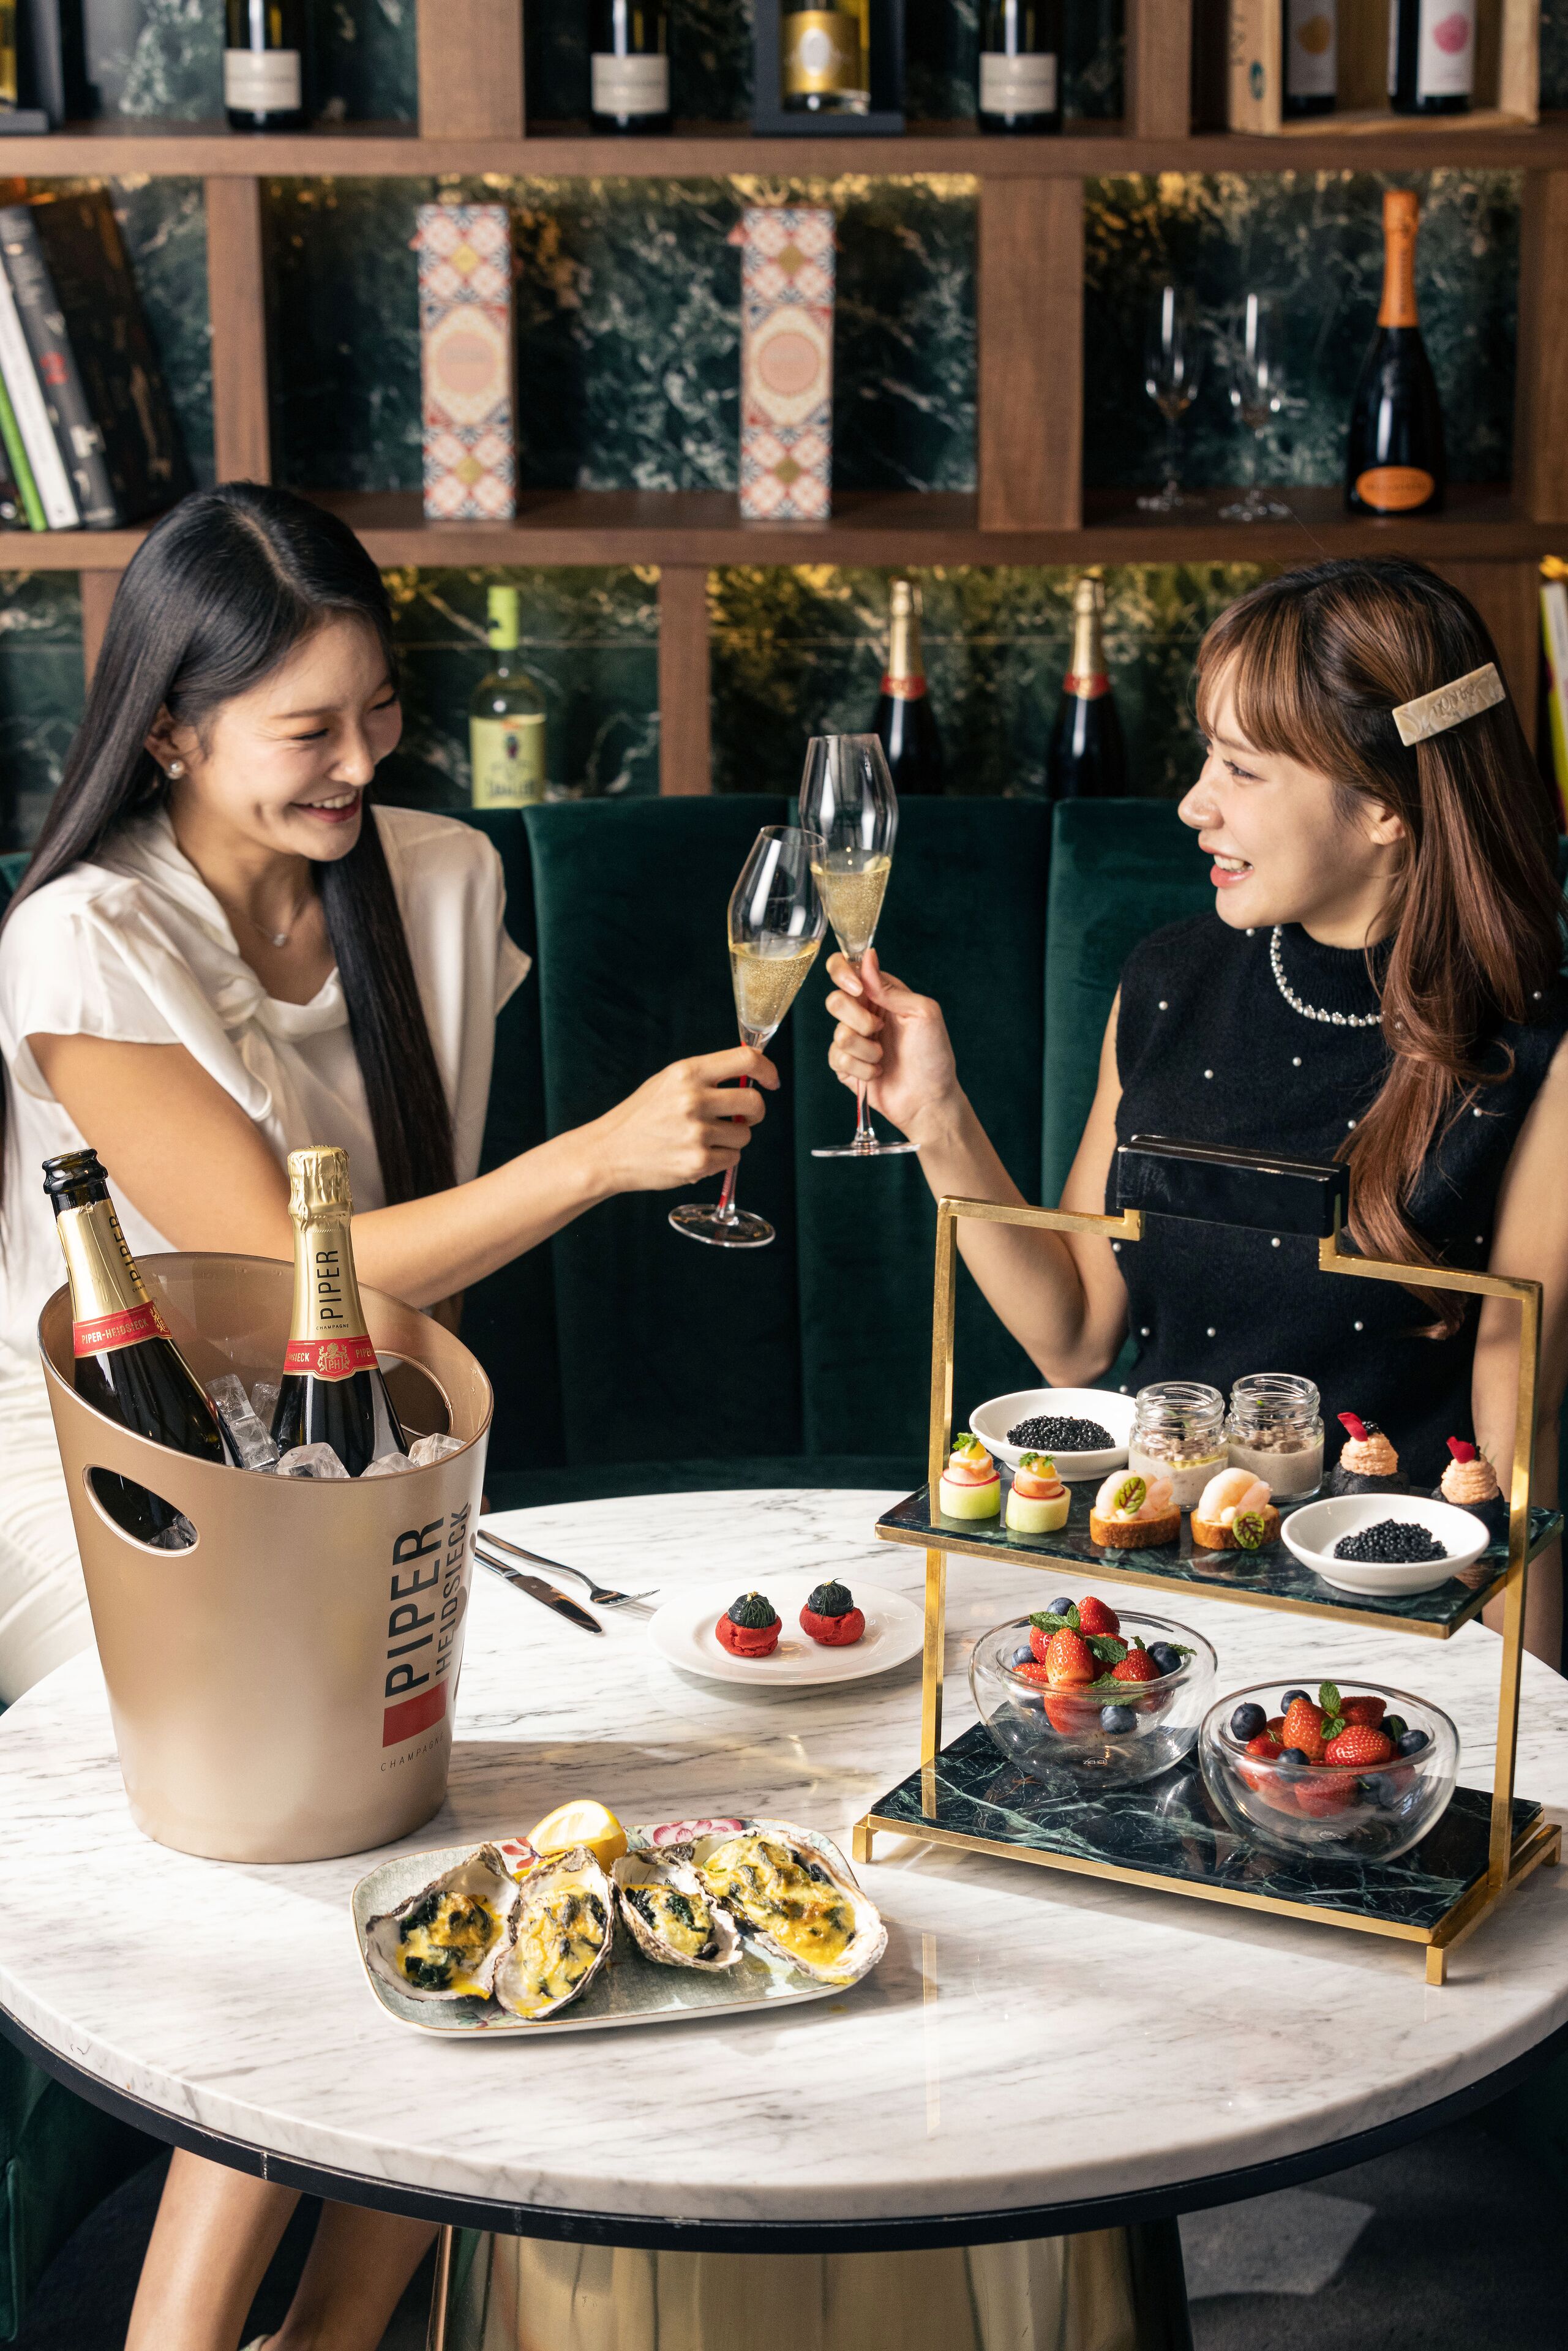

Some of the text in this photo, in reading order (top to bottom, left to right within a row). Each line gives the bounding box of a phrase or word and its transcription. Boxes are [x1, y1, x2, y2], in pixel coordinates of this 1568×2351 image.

[316, 1250, 343, 1319] PIPER
[81, 1318, 149, 1344] PIPER-HEIDSIECK
[384, 1517, 445, 1698] PIPER
[435, 1501, 469, 1676] HEIDSIECK
[381, 1732, 444, 1772] CHAMPAGNE
